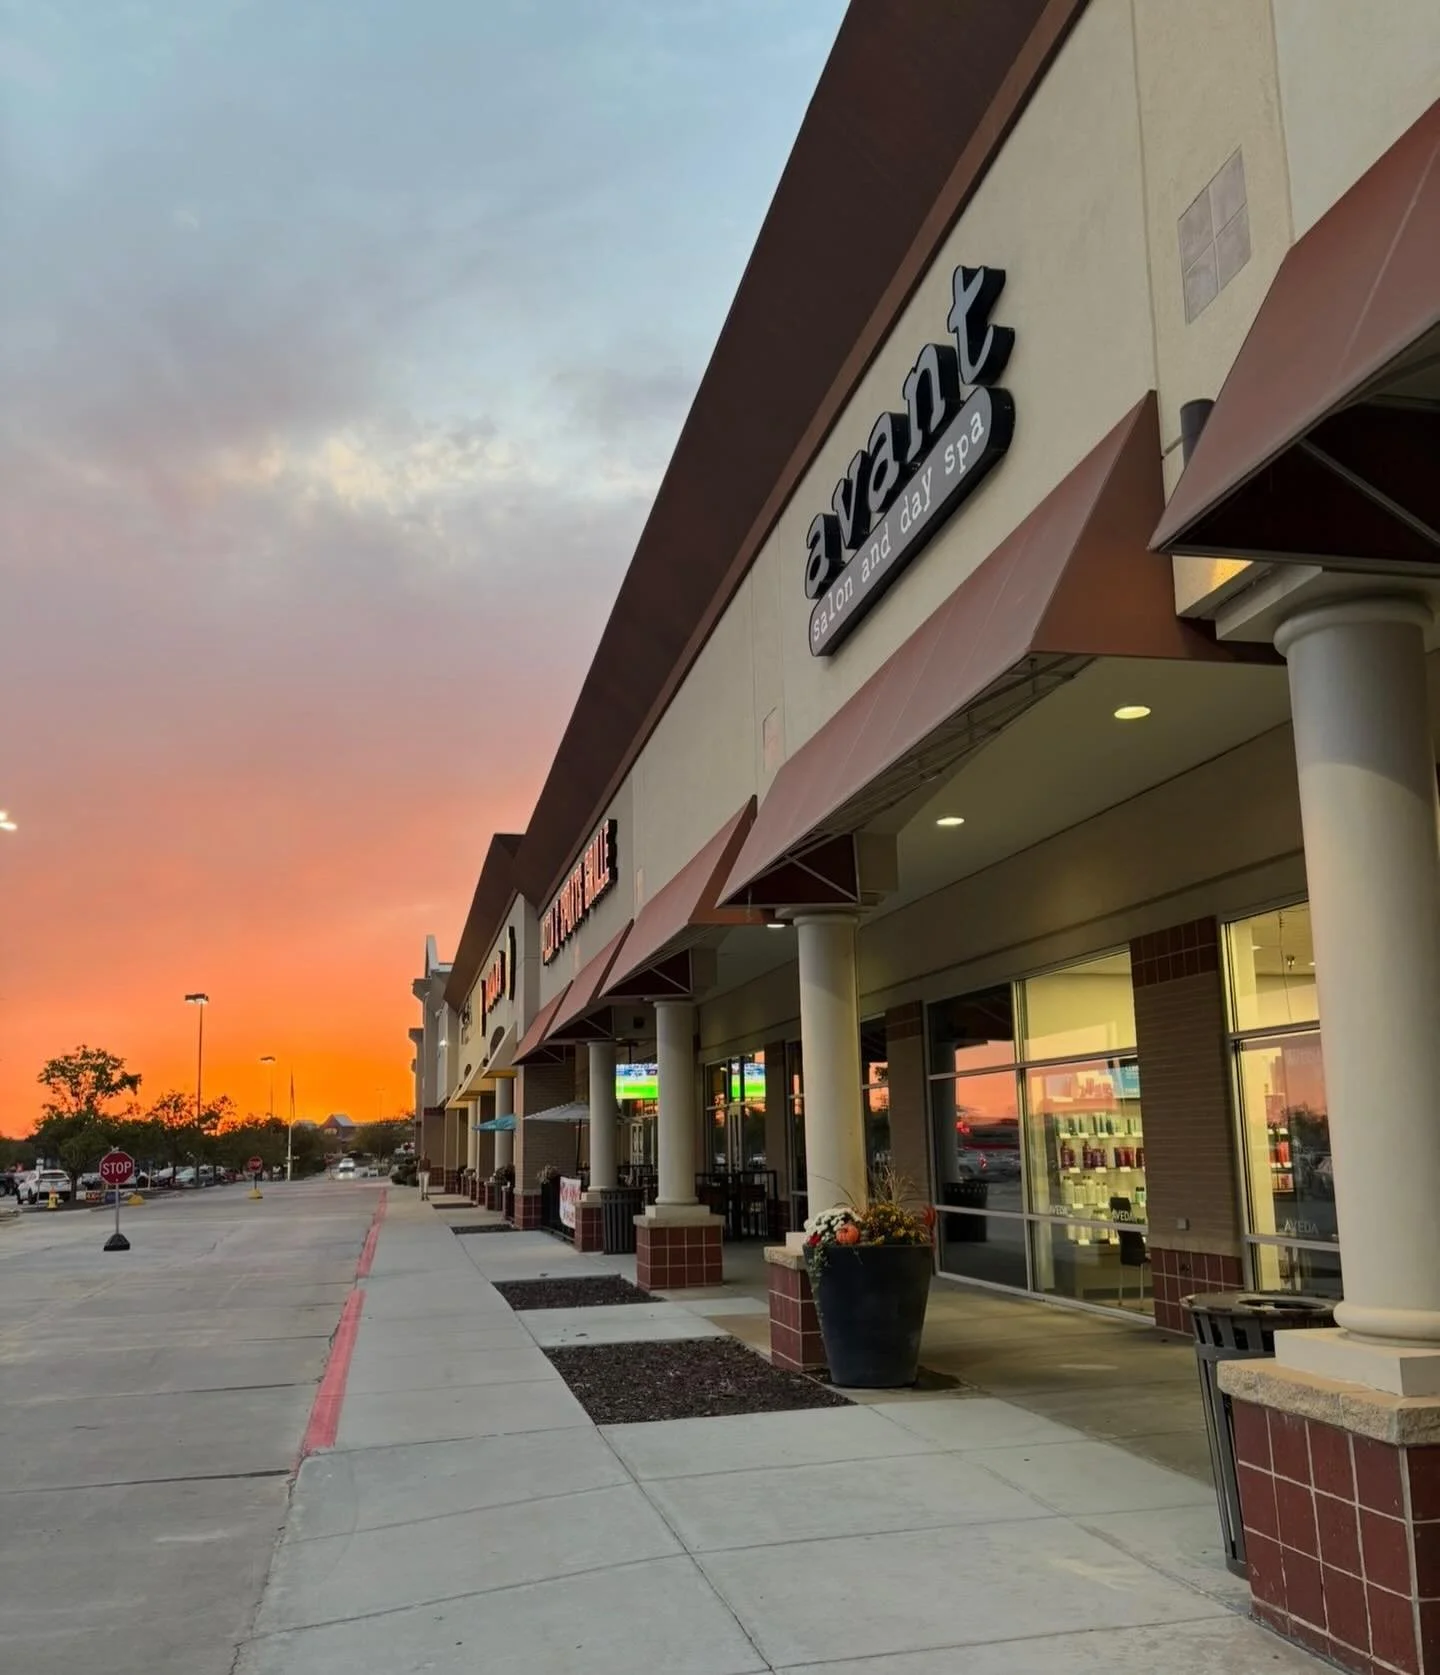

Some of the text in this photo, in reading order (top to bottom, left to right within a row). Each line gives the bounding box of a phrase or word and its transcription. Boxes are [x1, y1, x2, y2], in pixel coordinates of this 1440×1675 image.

[805, 264, 1015, 599] avant
[813, 408, 985, 642] salon and day spa
[102, 1161, 132, 1175] STOP
[1284, 1218, 1320, 1235] AVEDA
